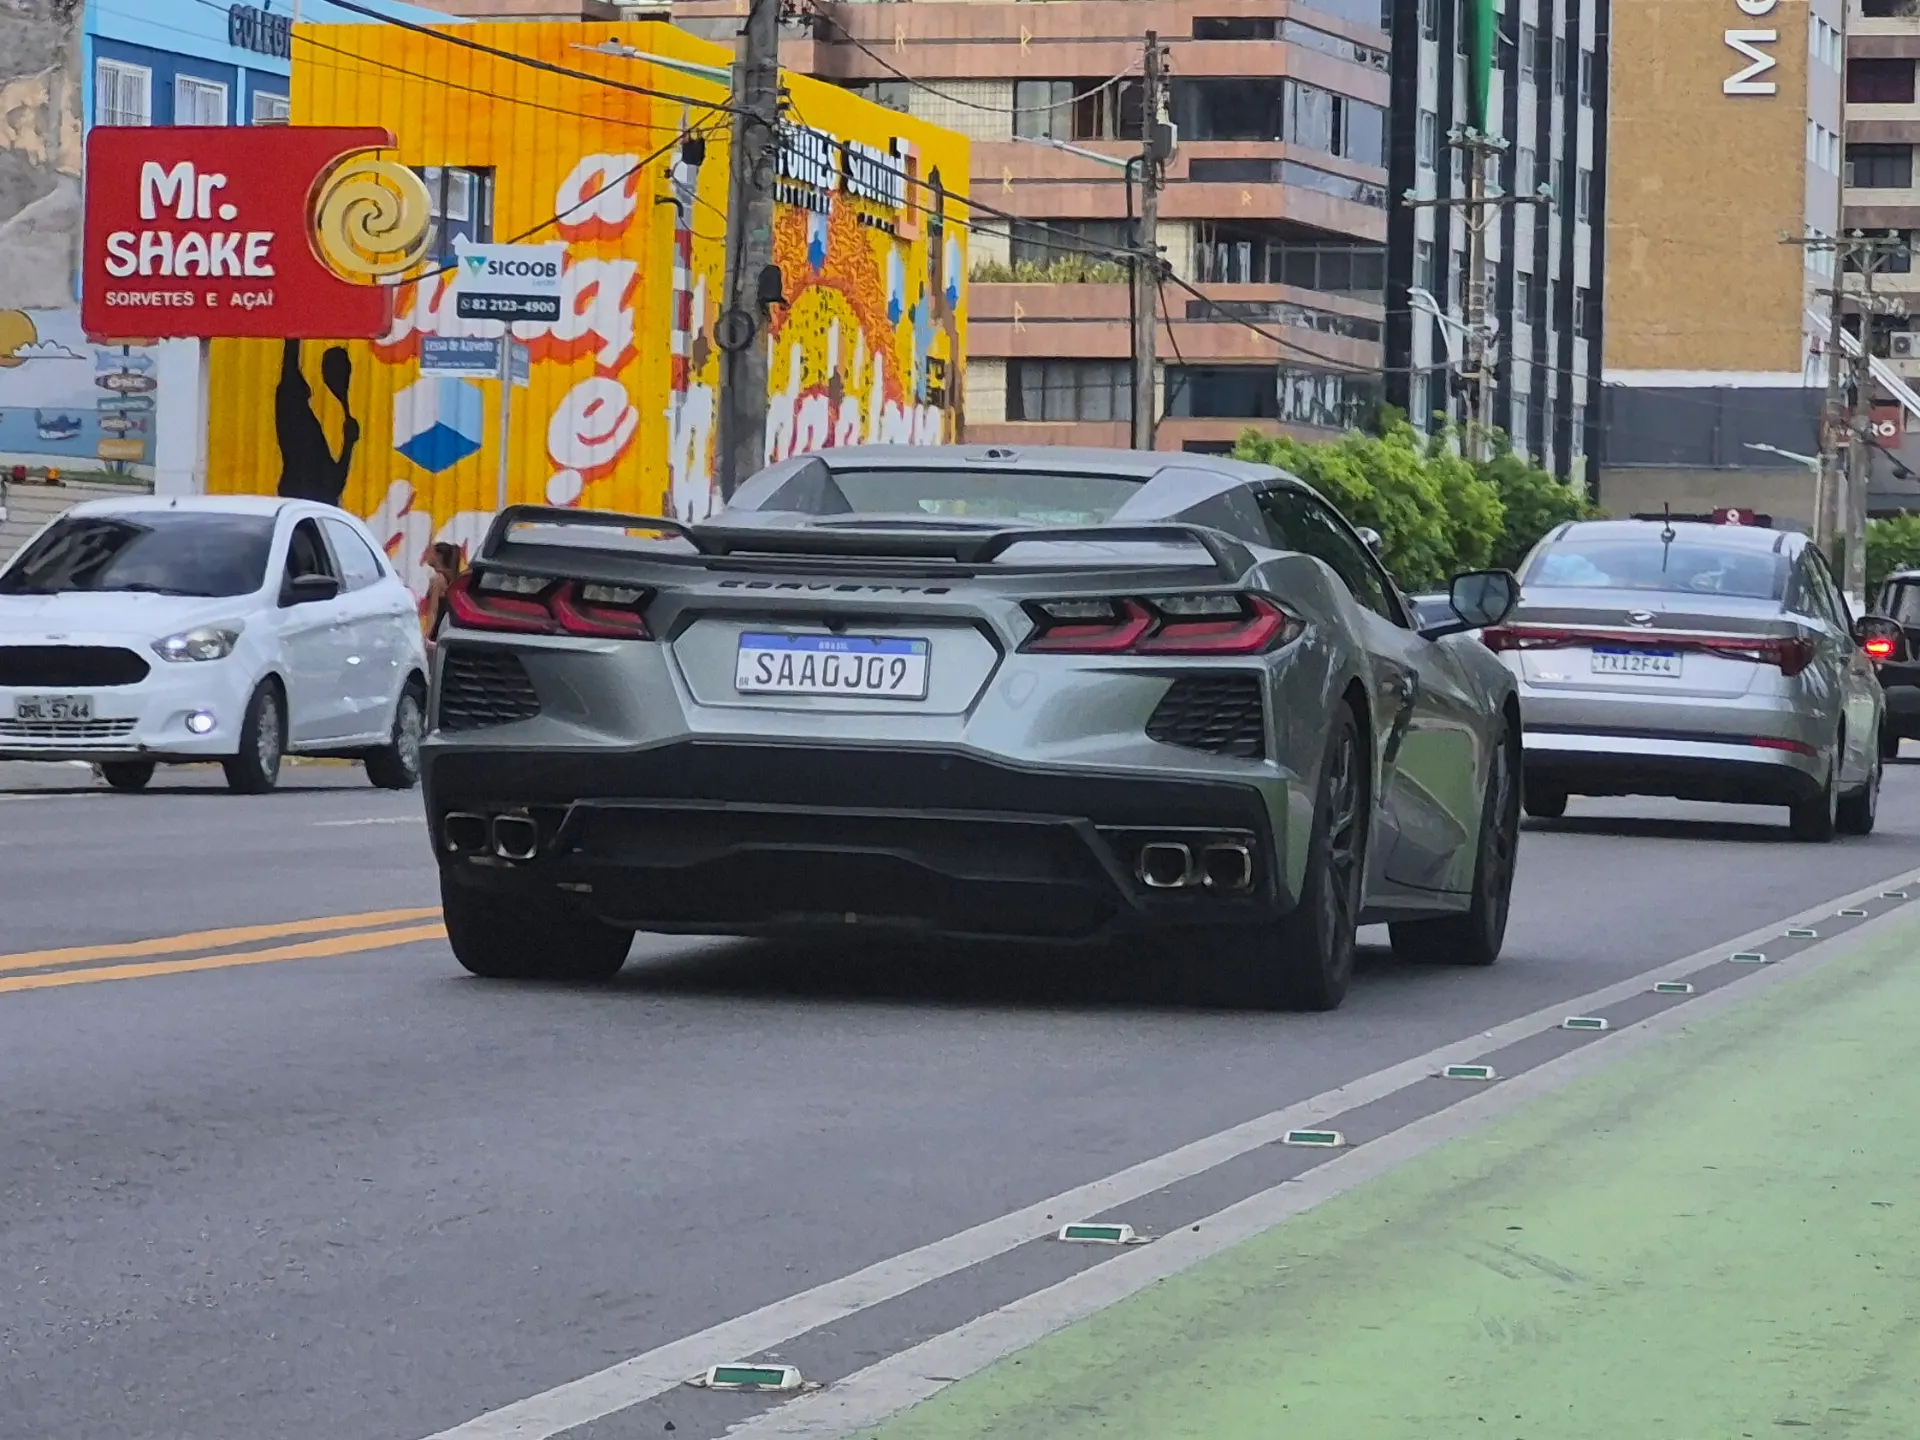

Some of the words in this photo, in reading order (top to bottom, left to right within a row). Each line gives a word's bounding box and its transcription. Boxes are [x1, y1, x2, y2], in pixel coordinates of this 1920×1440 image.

[140, 161, 237, 220] Mr.
[105, 231, 275, 277] SHAKE
[487, 259, 557, 278] SICOOB
[106, 291, 194, 306] SORVETES
[206, 292, 218, 306] E
[472, 299, 487, 310] 82
[717, 580, 951, 595] CORVETTE
